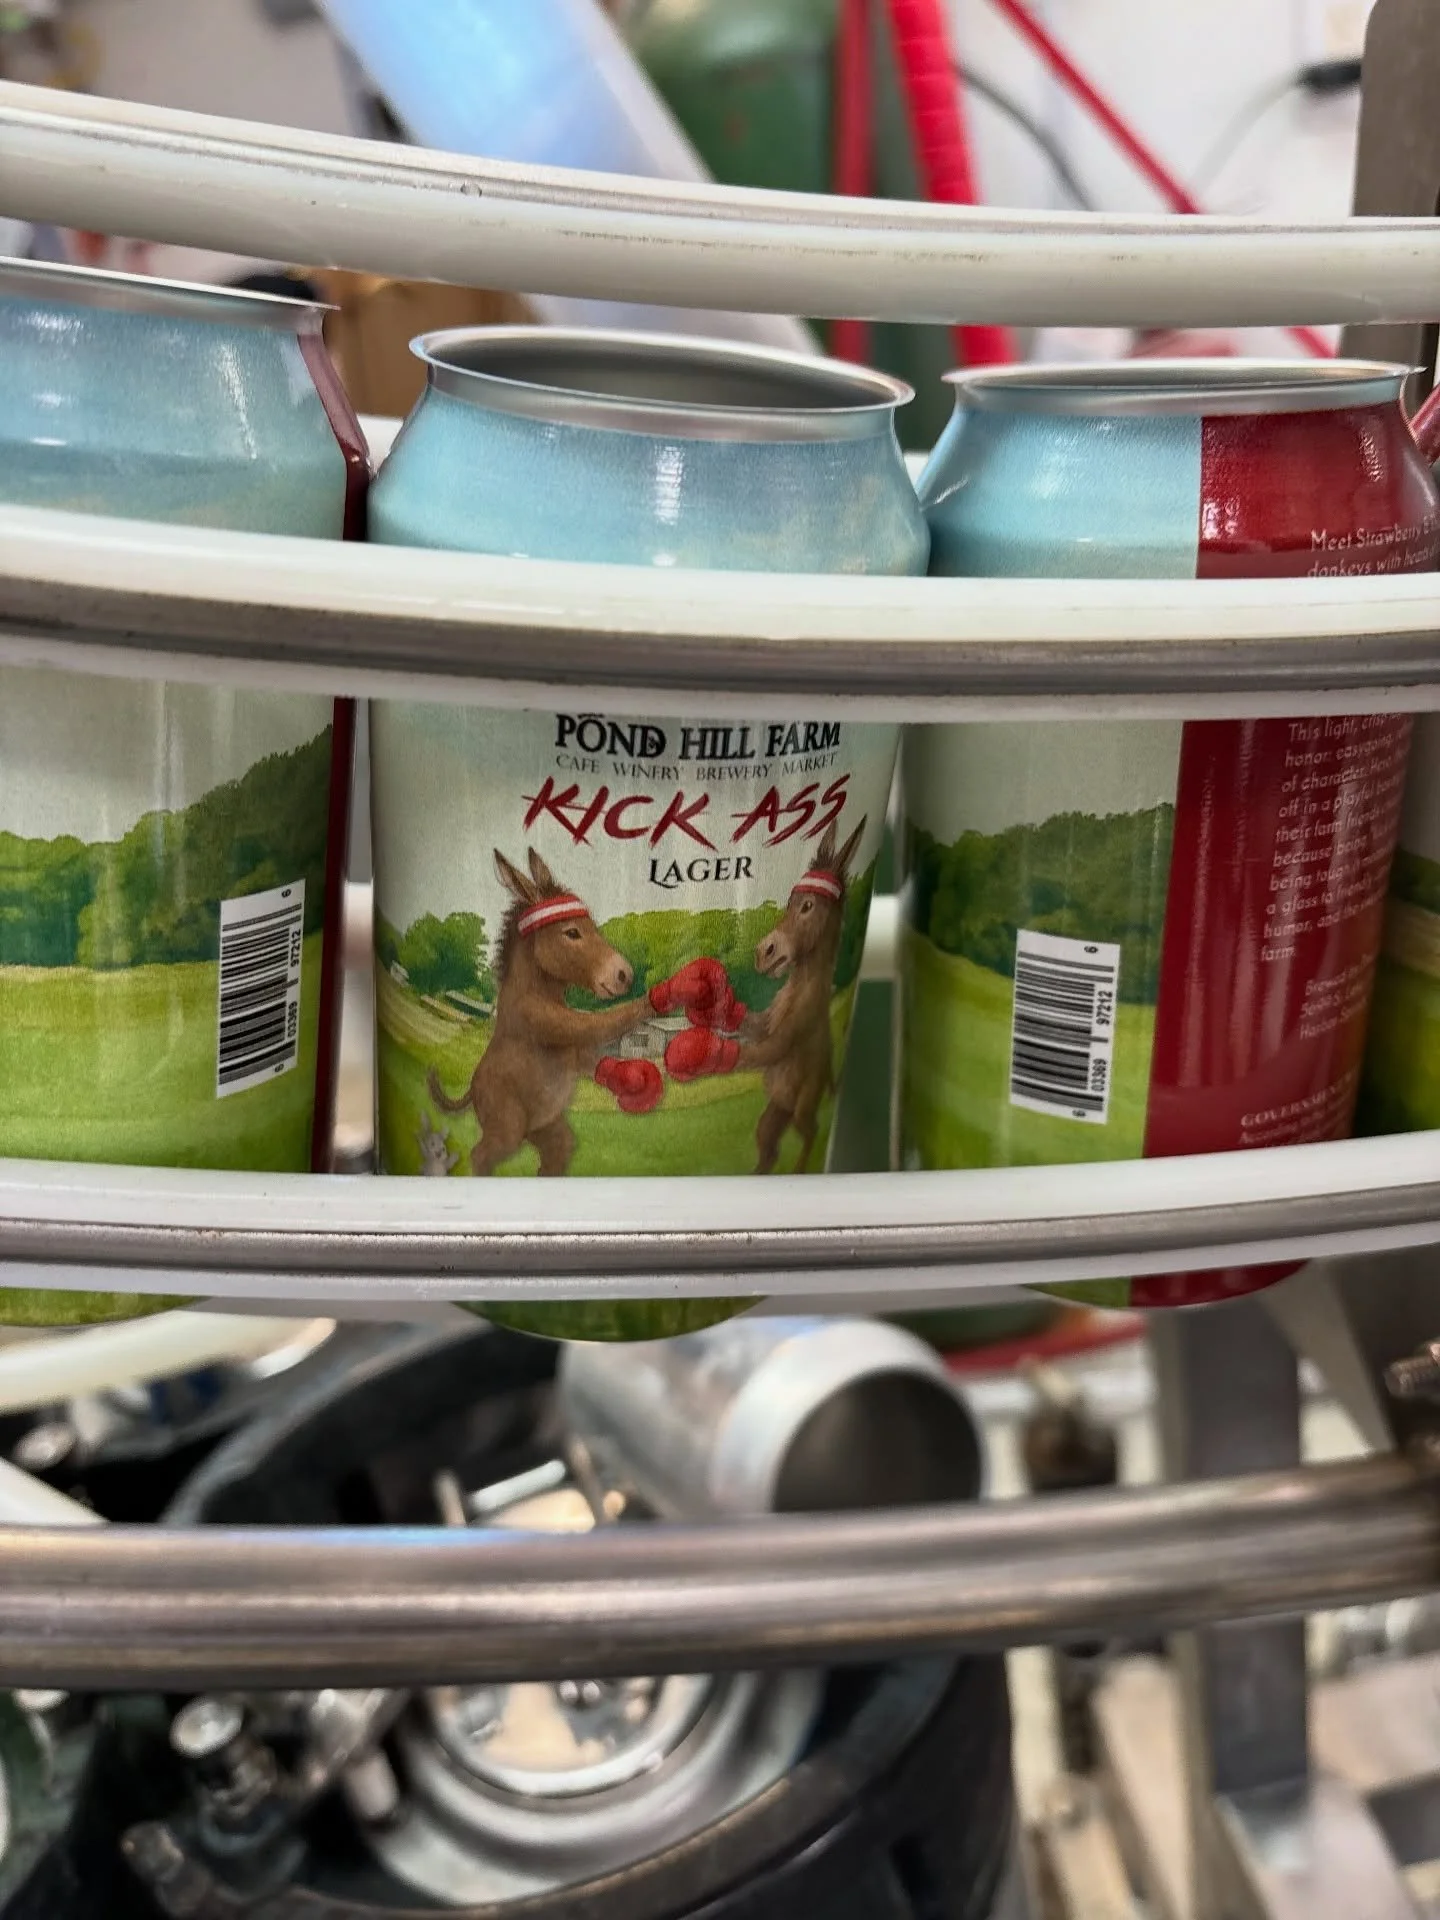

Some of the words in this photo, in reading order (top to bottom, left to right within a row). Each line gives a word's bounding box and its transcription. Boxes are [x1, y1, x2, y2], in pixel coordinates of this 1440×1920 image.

[1310, 528, 1352, 552] Meet
[1356, 522, 1421, 549] Strawberry
[1307, 557, 1371, 576] donkeys
[678, 726, 756, 760] HILL
[765, 721, 841, 757] FARM
[1288, 722, 1320, 742] This
[556, 754, 600, 773] CAFE
[613, 761, 684, 780] WINERY
[696, 763, 773, 781] BREWERY
[782, 751, 837, 777] MARKET
[1280, 773, 1299, 793] of
[521, 775, 718, 852] KICK
[729, 772, 851, 848] ASS
[1278, 796, 1301, 818] off
[1302, 796, 1318, 815] in
[1320, 799, 1331, 811] a
[1275, 822, 1313, 844] their
[1272, 846, 1333, 868] because
[649, 855, 754, 889] LAGER
[1268, 873, 1313, 892] being
[281, 888, 291, 898] 6
[1265, 903, 1276, 915] a
[1281, 895, 1319, 917] glass
[1317, 908, 1341, 928] and
[290, 929, 301, 968] 97212
[1084, 945, 1098, 954] 6
[1096, 990, 1113, 1026] 97212
